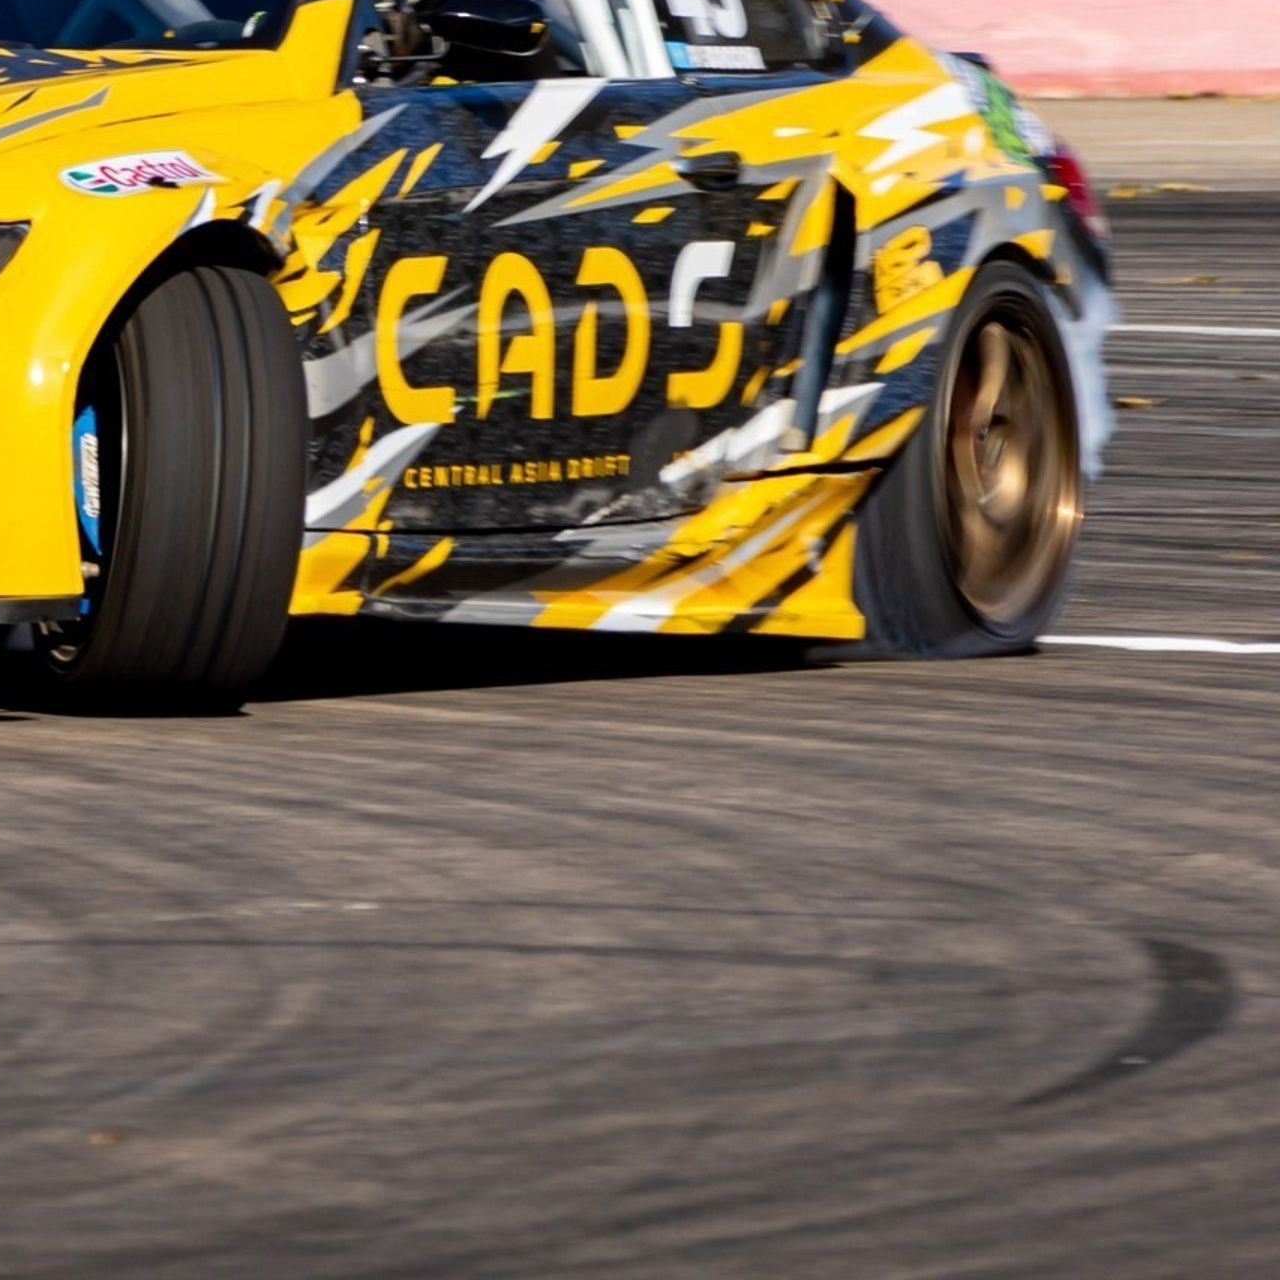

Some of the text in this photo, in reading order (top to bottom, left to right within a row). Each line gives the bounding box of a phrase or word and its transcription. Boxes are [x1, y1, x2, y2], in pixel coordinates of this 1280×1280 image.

[375, 241, 744, 424] CADS
[404, 454, 631, 489] CENTRAL ASIA DRIFT
